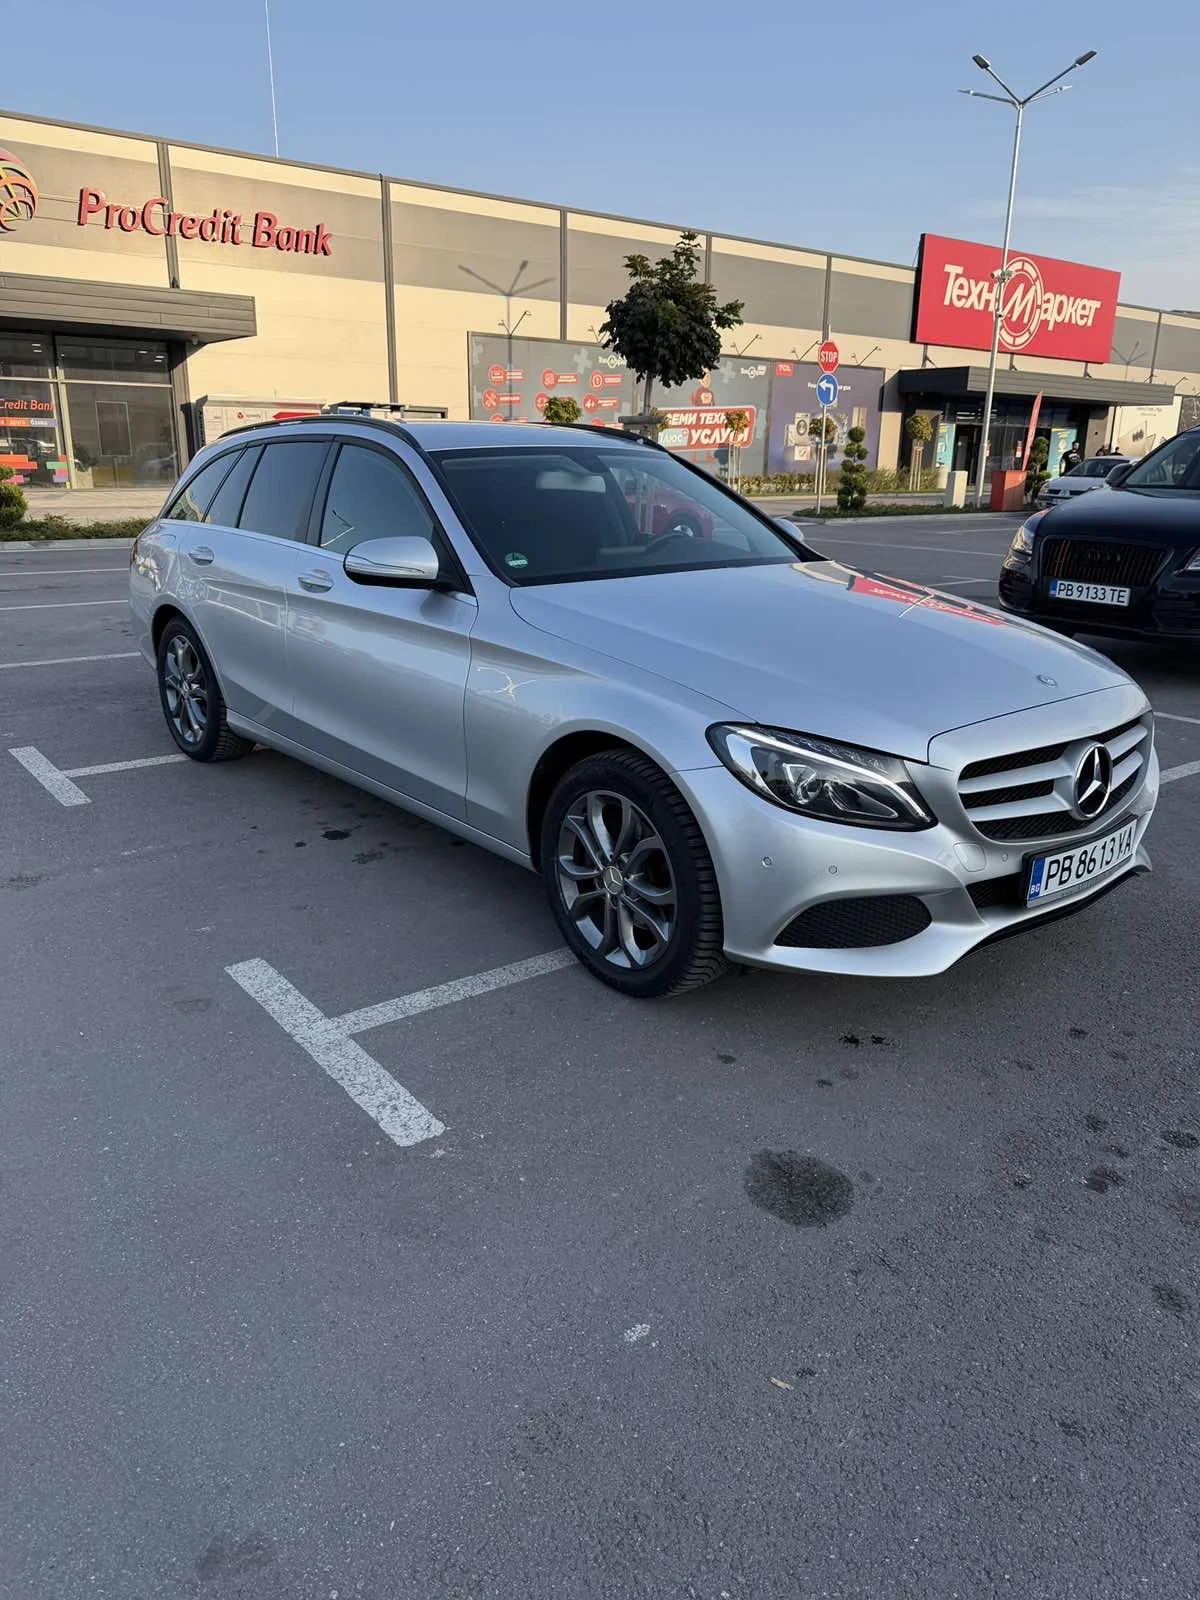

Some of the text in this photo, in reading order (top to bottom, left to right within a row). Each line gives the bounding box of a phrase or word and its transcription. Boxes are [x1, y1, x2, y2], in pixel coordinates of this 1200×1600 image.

[78, 187, 334, 256] ProCredit Bank
[820, 350, 838, 363] STOP
[778, 364, 791, 372] TCL
[666, 412, 698, 426] ЗЕМИ
[1057, 582, 1074, 597] PB
[1076, 585, 1106, 601] 9133
[1109, 588, 1127, 603] TE
[1045, 855, 1074, 890] PB
[1075, 838, 1116, 879] 8613
